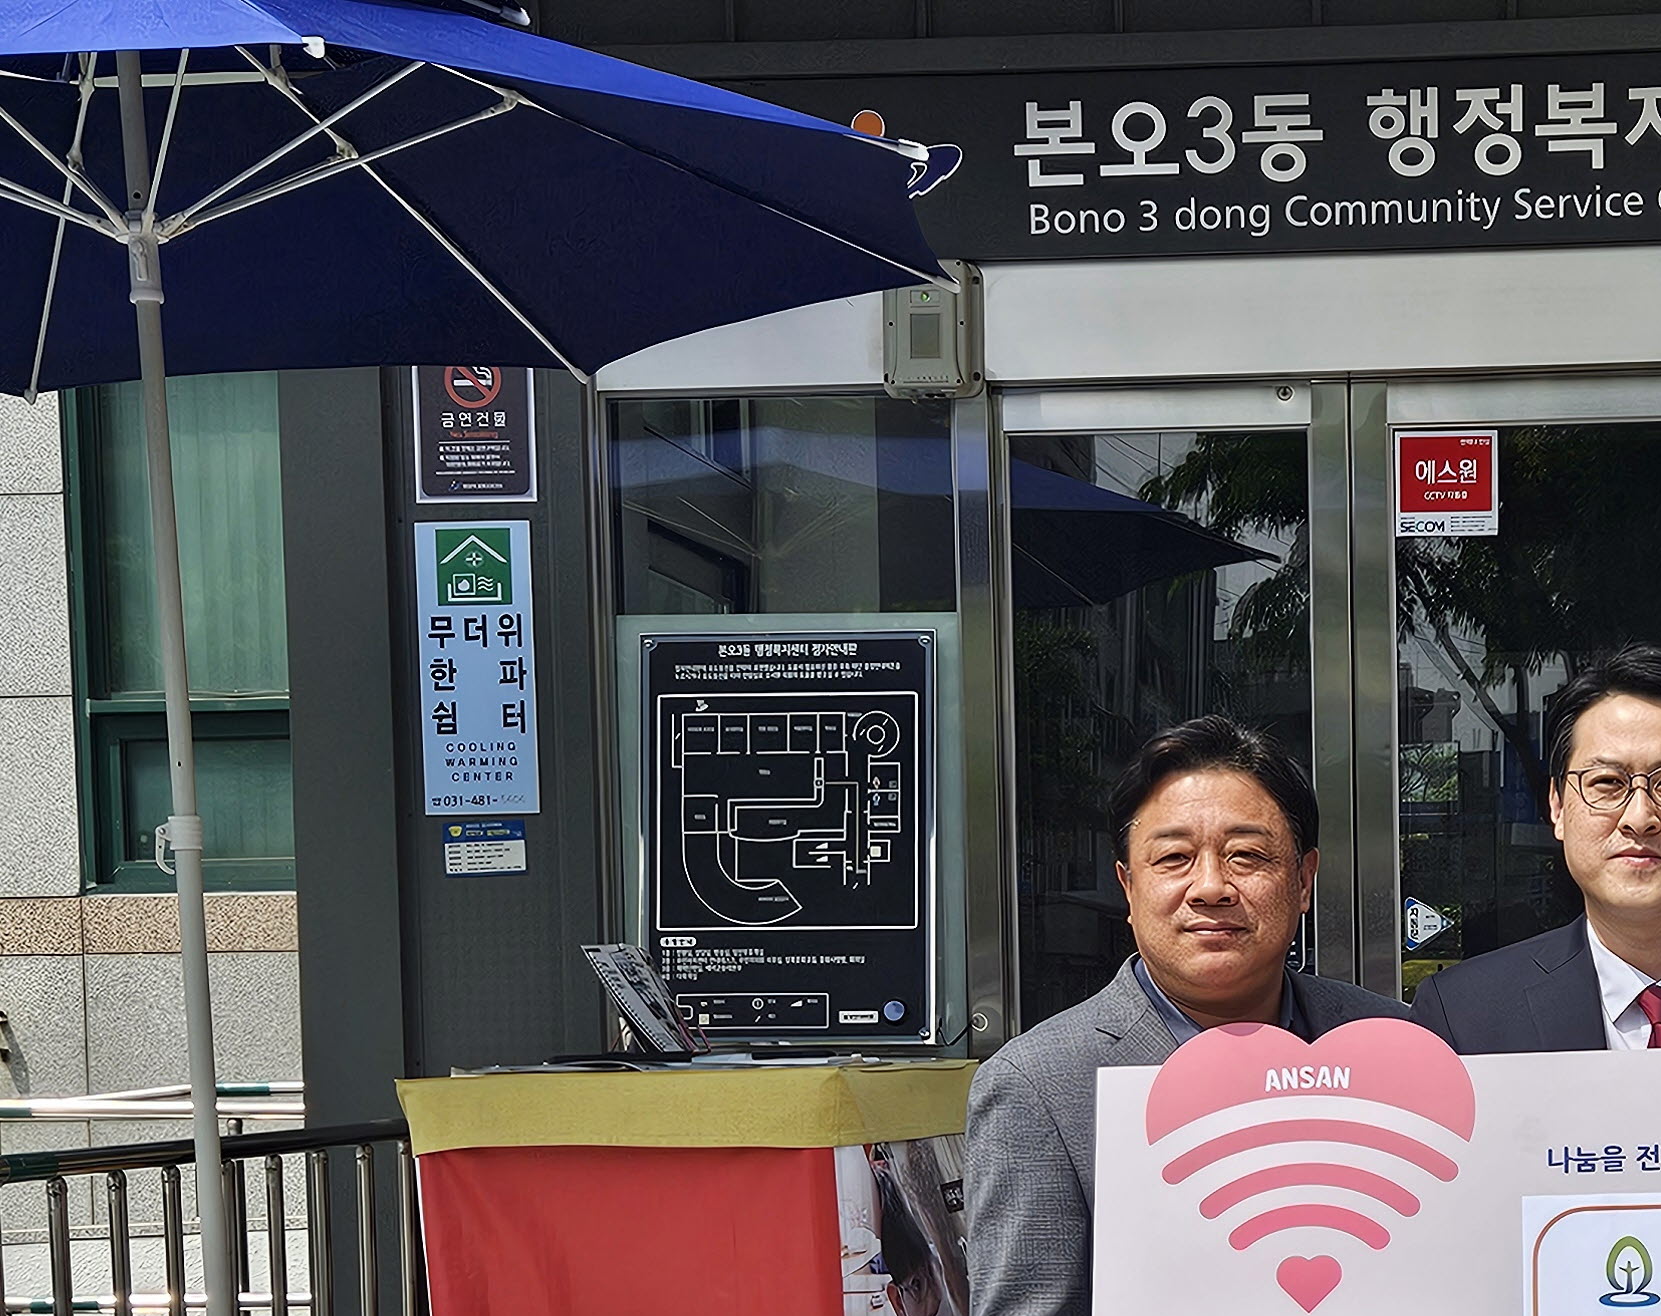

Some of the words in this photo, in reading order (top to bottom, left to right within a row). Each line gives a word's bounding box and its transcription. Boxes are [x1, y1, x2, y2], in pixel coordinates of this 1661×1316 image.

[1013, 93, 1324, 188] 본오3동
[1029, 203, 1126, 235] Bono
[1138, 200, 1159, 232] 3
[1174, 196, 1271, 238] dong
[1284, 187, 1502, 230] Community
[1513, 184, 1645, 220] Service
[1414, 458, 1477, 485] 에스원
[1399, 520, 1446, 533] SECOM
[427, 612, 523, 649] 무더위
[445, 741, 517, 752] COOLING
[444, 756, 518, 767] WARMING
[451, 771, 514, 782] CENTER
[1264, 1065, 1352, 1093] ANSAN
[1547, 1143, 1627, 1174] 나눔을
